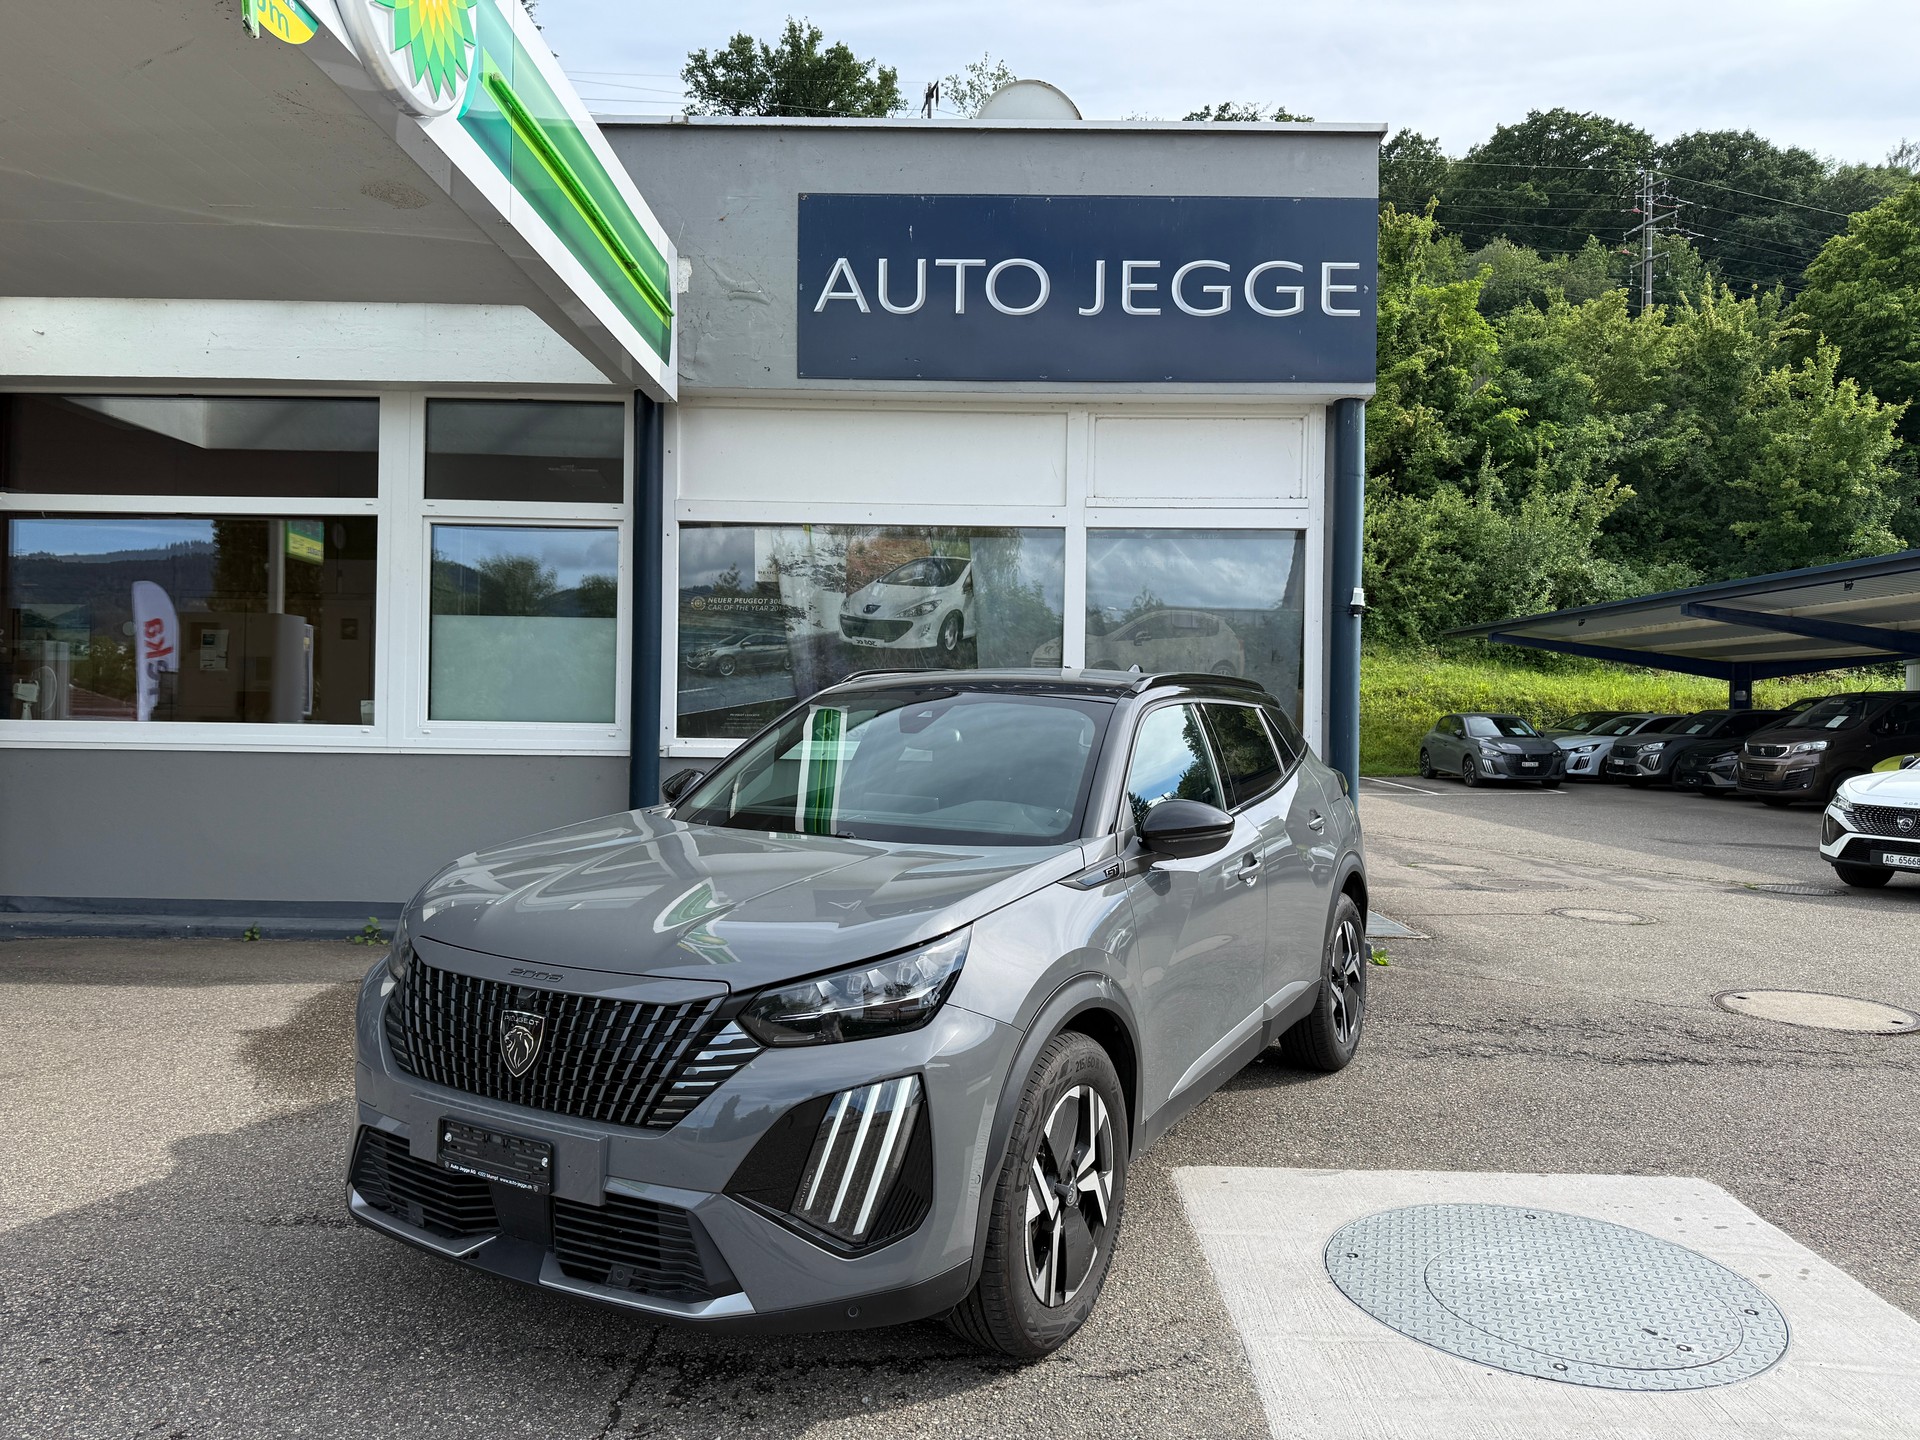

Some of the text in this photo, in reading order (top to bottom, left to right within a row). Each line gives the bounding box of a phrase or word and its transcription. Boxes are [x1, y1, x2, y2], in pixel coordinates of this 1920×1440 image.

[813, 257, 1361, 317] AUTO JEGGE
[734, 597, 768, 605] PEUGEOT
[1885, 854, 1894, 863] AG
[1105, 865, 1119, 877] GT
[507, 967, 565, 983] 2008
[504, 1015, 540, 1026] PEUGEOT
[459, 1166, 471, 1174] Jegge
